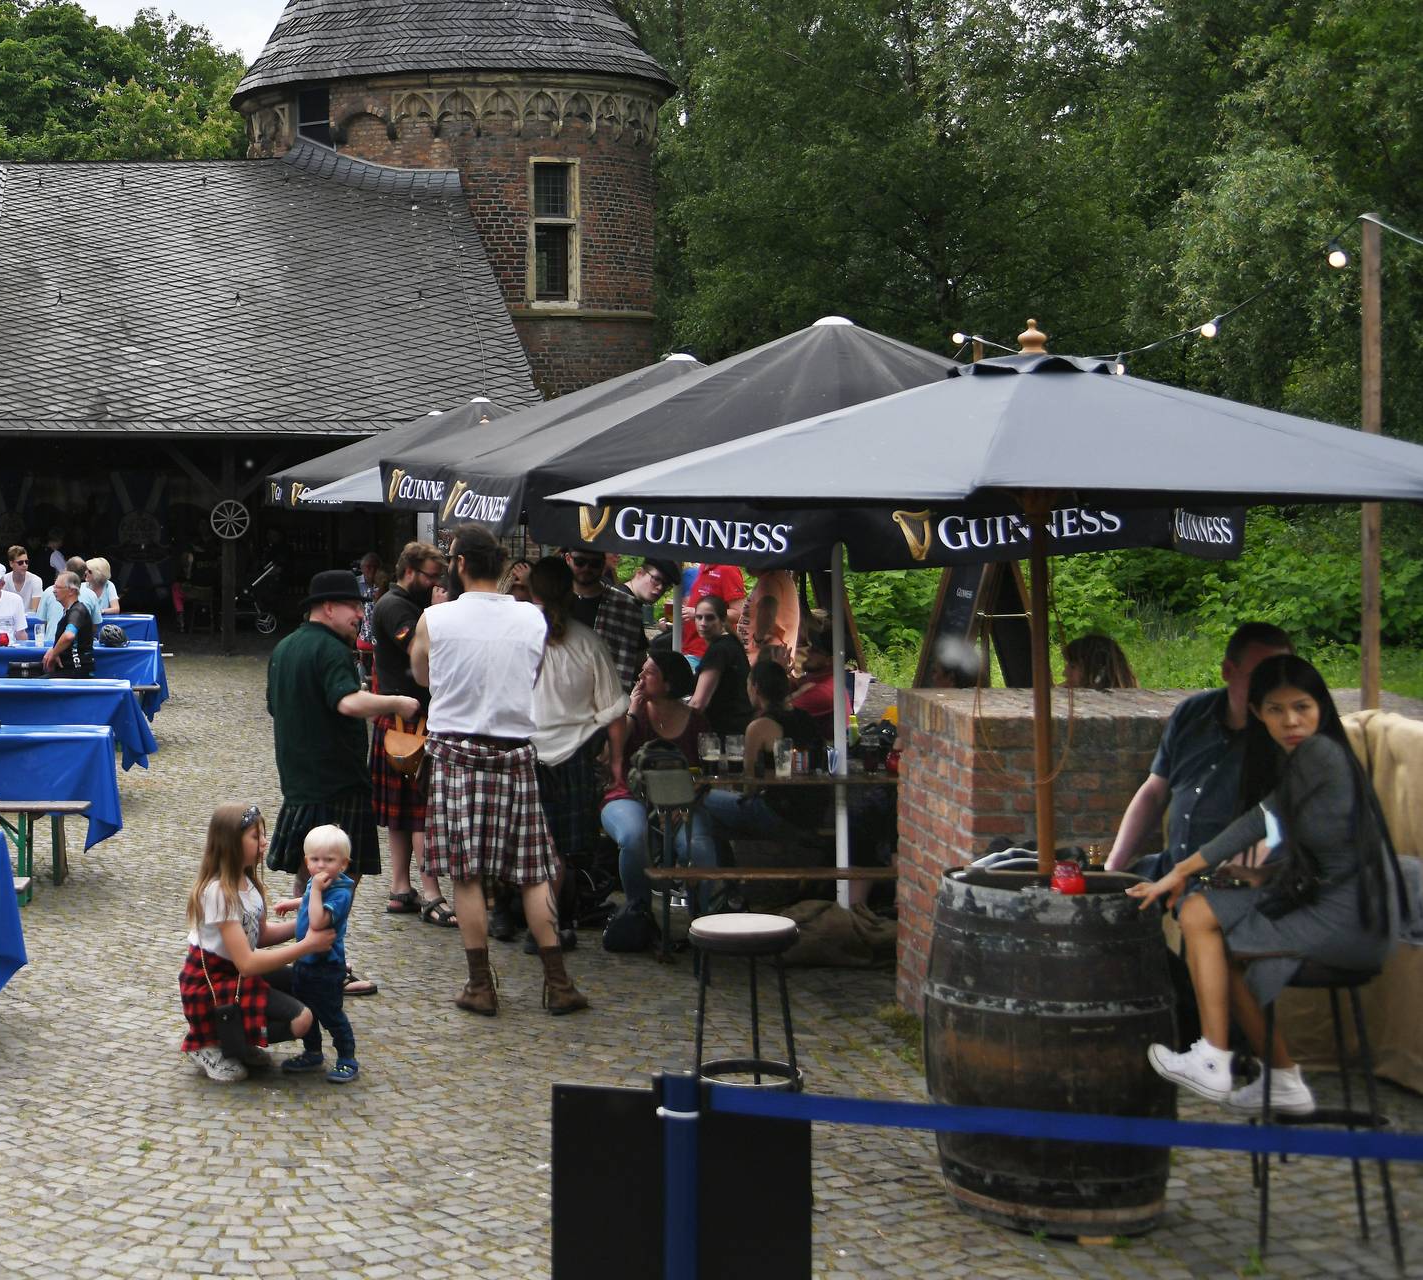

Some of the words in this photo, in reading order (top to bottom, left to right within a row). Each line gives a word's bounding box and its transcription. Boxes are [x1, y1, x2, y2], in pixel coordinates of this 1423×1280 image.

[398, 475, 444, 501] GUINNE
[614, 506, 791, 553] GUINNESS
[1174, 508, 1233, 544] GUINNESS
